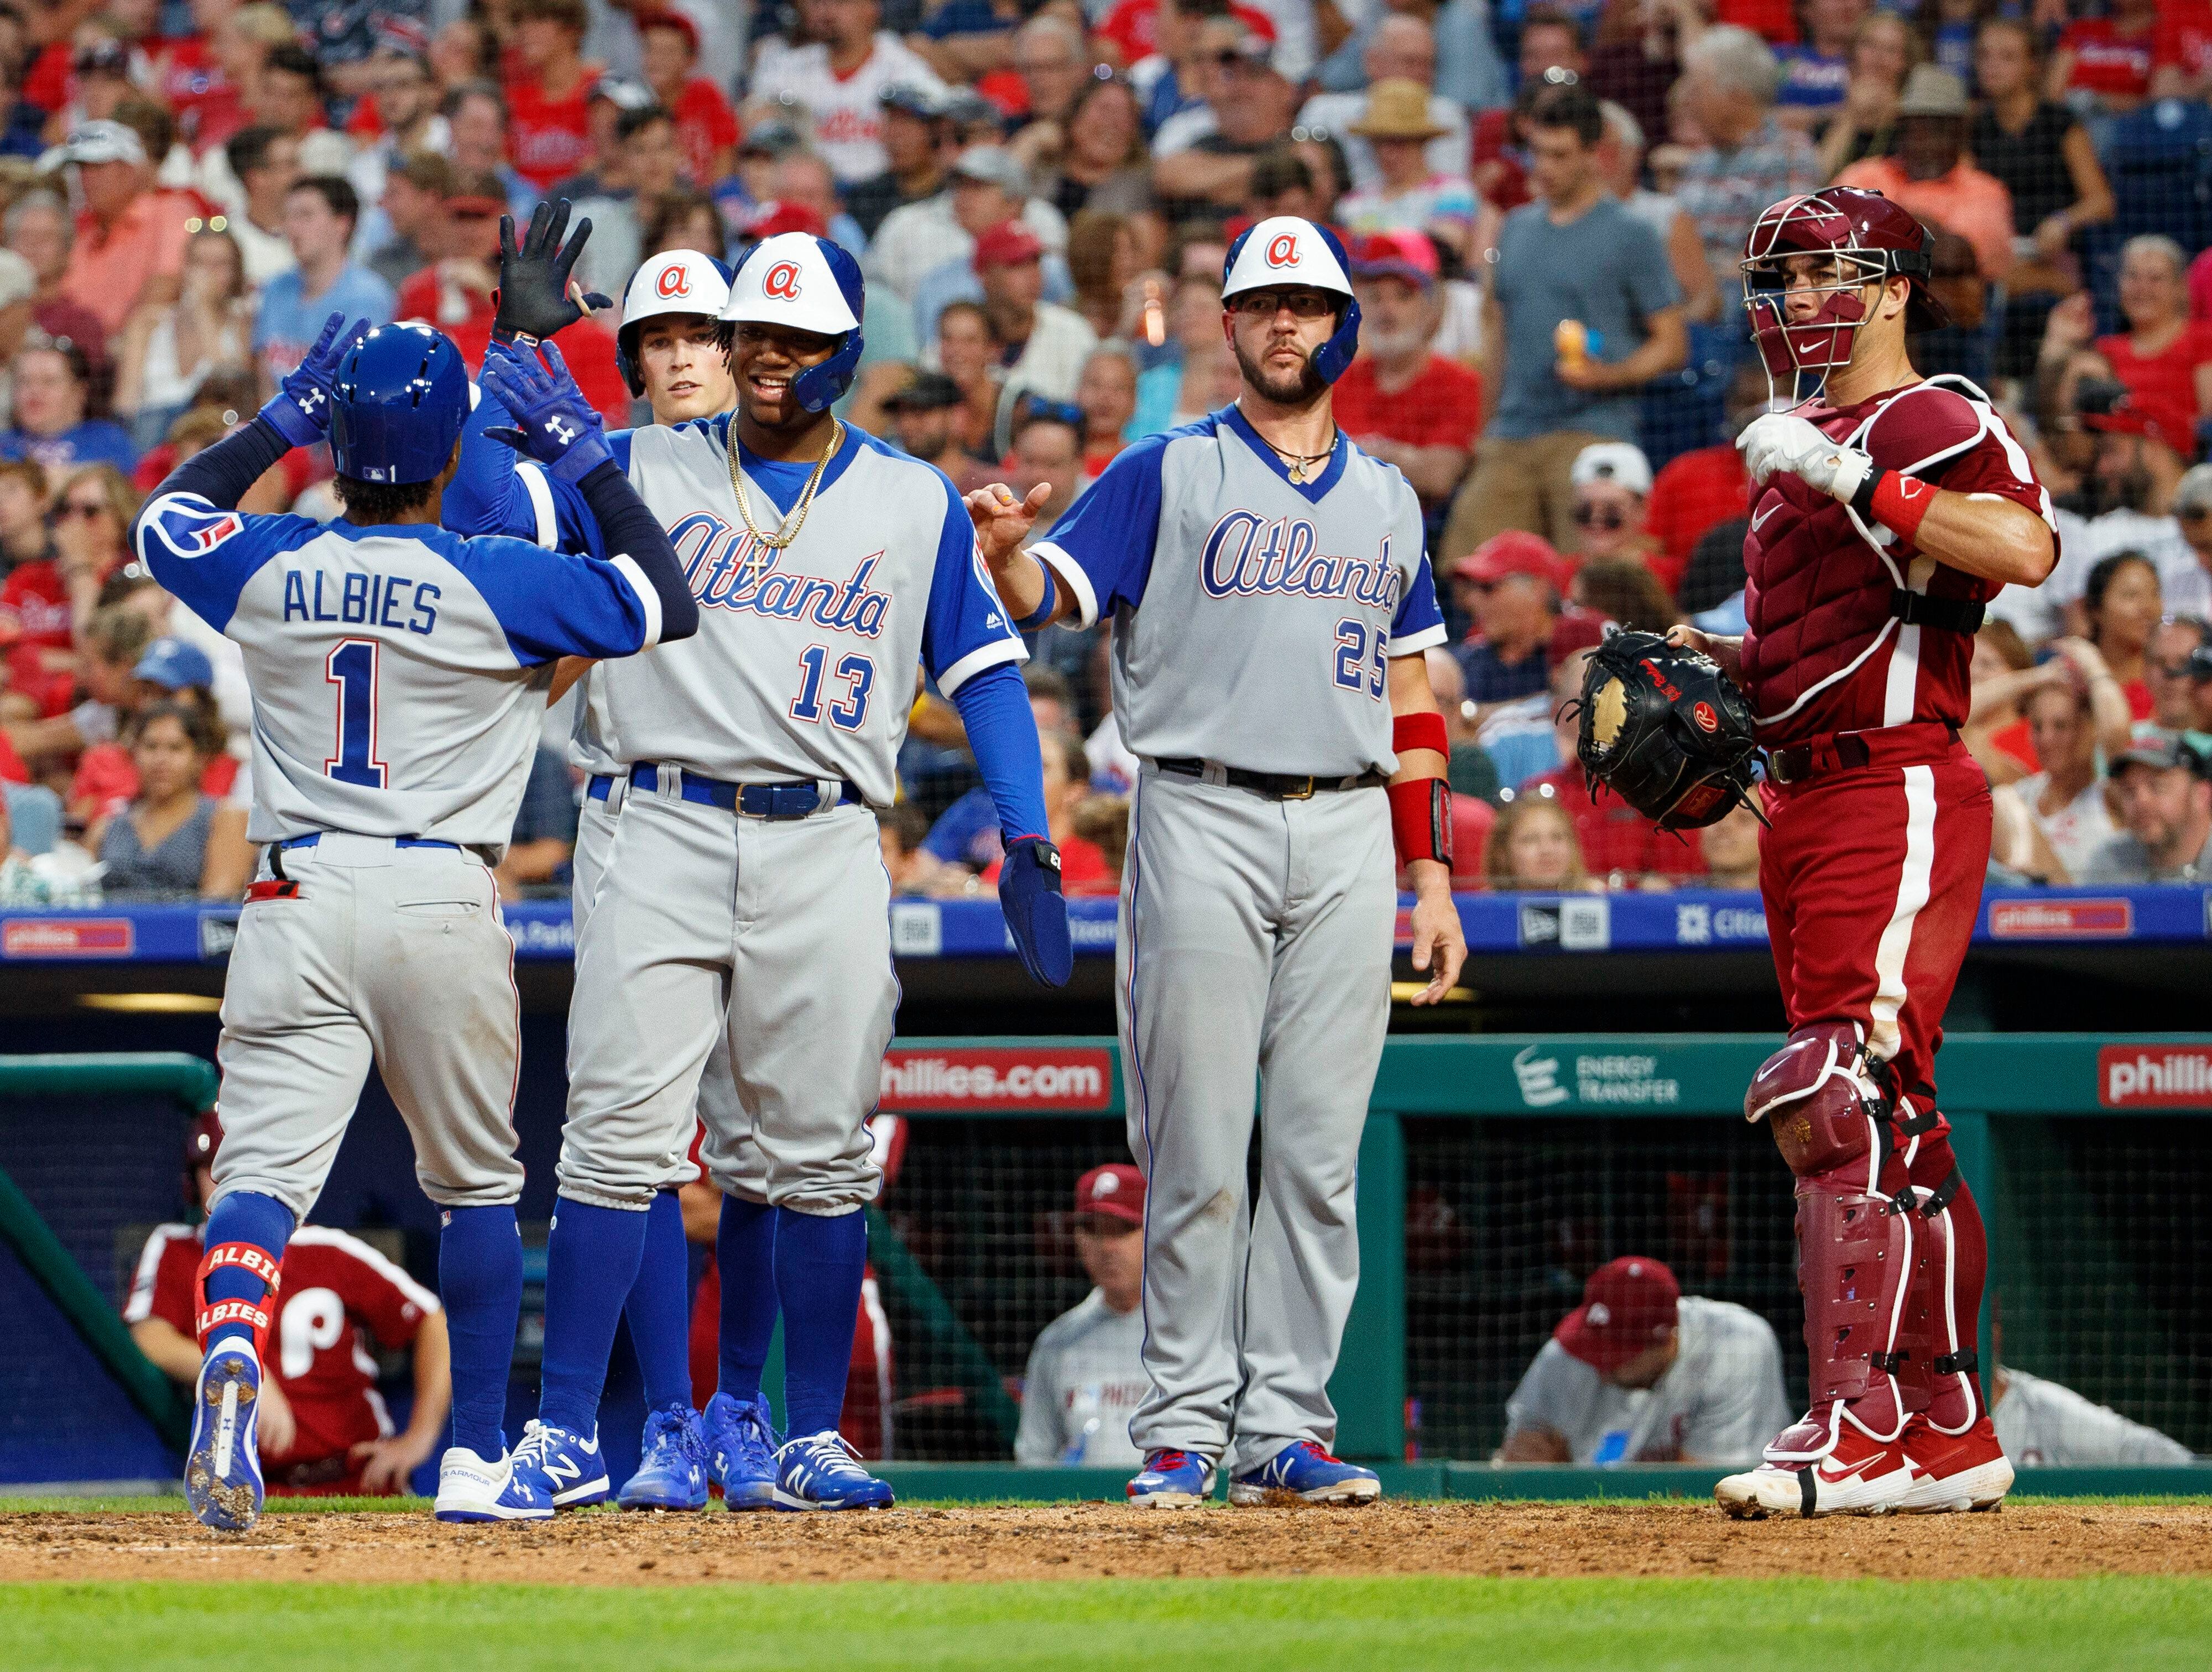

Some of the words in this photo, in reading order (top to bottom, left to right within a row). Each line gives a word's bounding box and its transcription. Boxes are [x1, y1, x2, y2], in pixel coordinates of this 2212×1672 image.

[1265, 232, 1302, 269] a
[656, 264, 692, 299] a
[763, 260, 802, 302] a
[390, 465, 395, 482] 1
[667, 511, 892, 640] Atlanta
[1199, 509, 1401, 614] Atlanta
[285, 570, 441, 635] ALBIES
[1333, 616, 1387, 702] 25
[789, 643, 877, 733] 13
[324, 636, 388, 789] 1
[1577, 1055, 1657, 1076] ENERGY
[2110, 1054, 2212, 1103] philli
[1578, 1079, 1680, 1104] TRANSFER
[450, 1470, 490, 1487] ARMOUR
